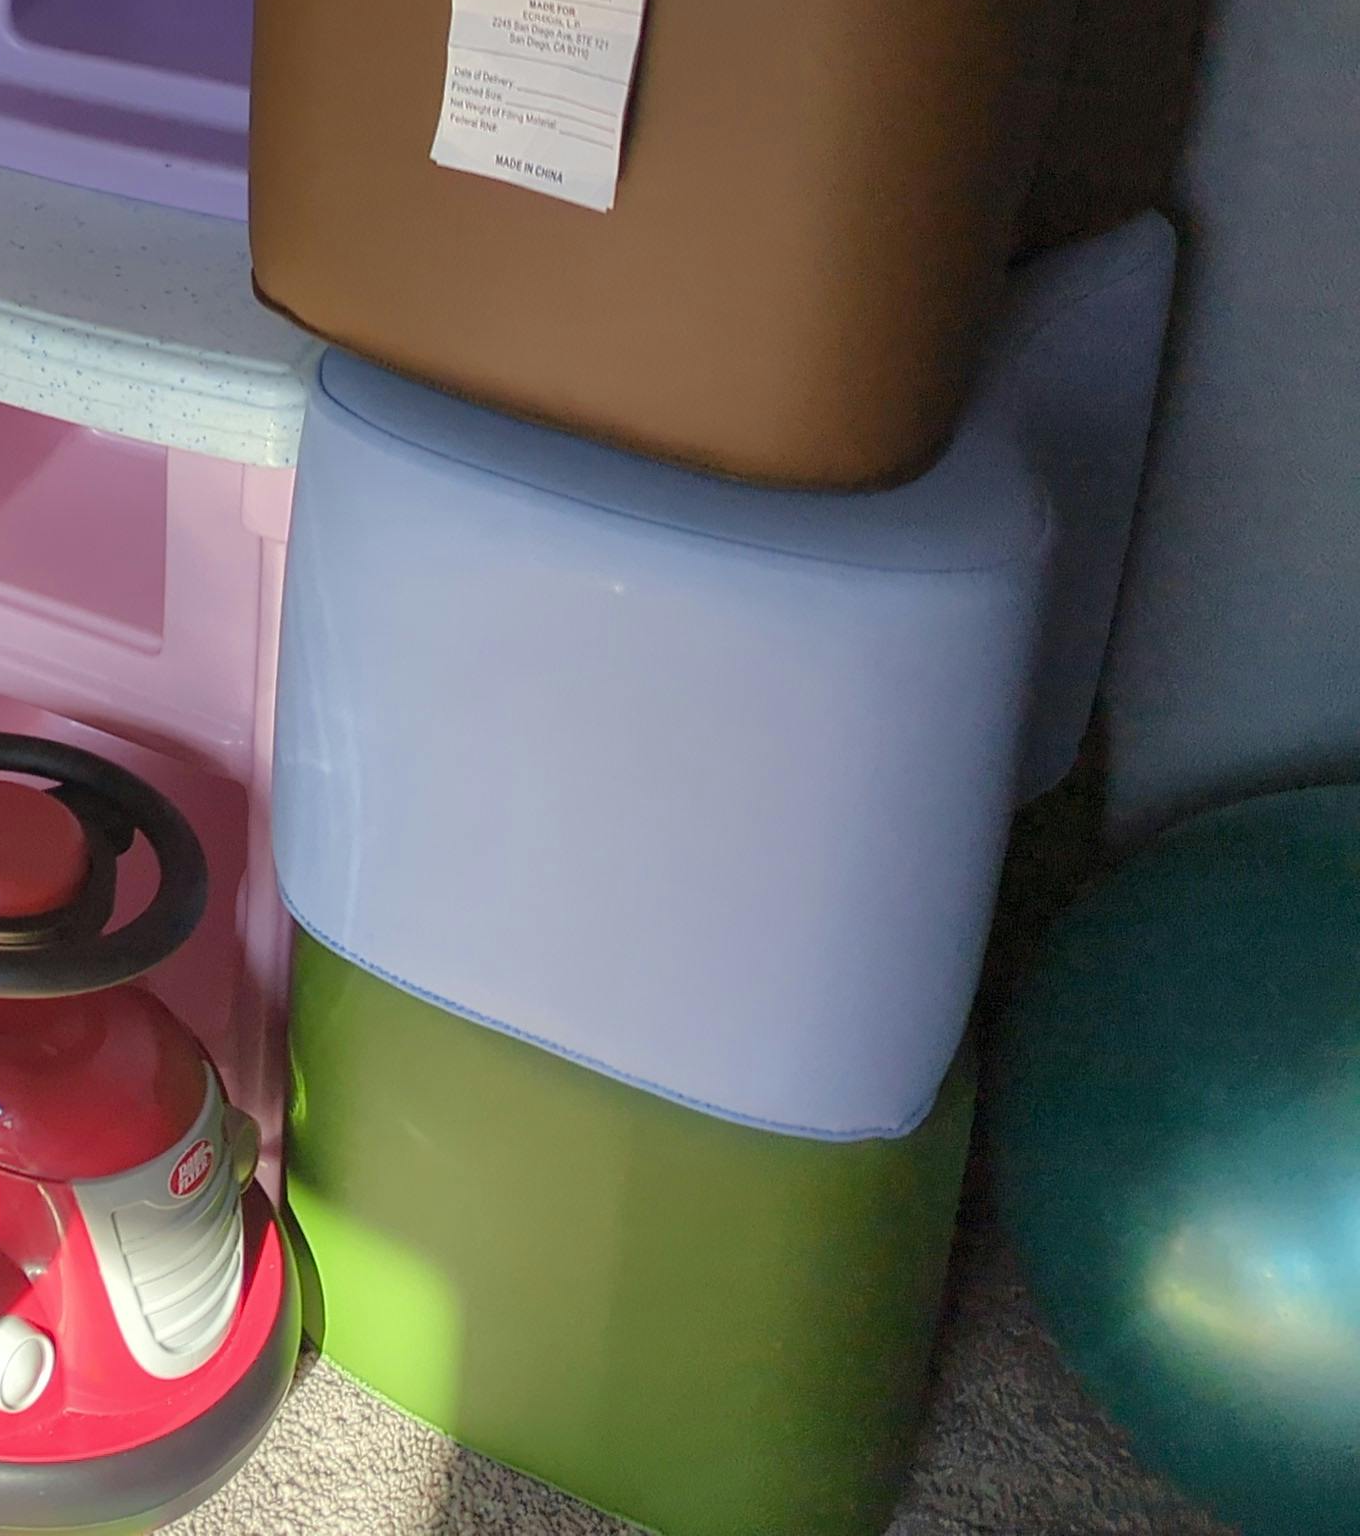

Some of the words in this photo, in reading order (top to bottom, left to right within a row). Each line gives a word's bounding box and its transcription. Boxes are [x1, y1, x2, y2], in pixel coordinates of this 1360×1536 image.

[529, 0, 555, 15] MADE
[556, 4, 576, 17] FOR
[495, 154, 522, 172] MADE
[534, 165, 564, 185] CHINA
